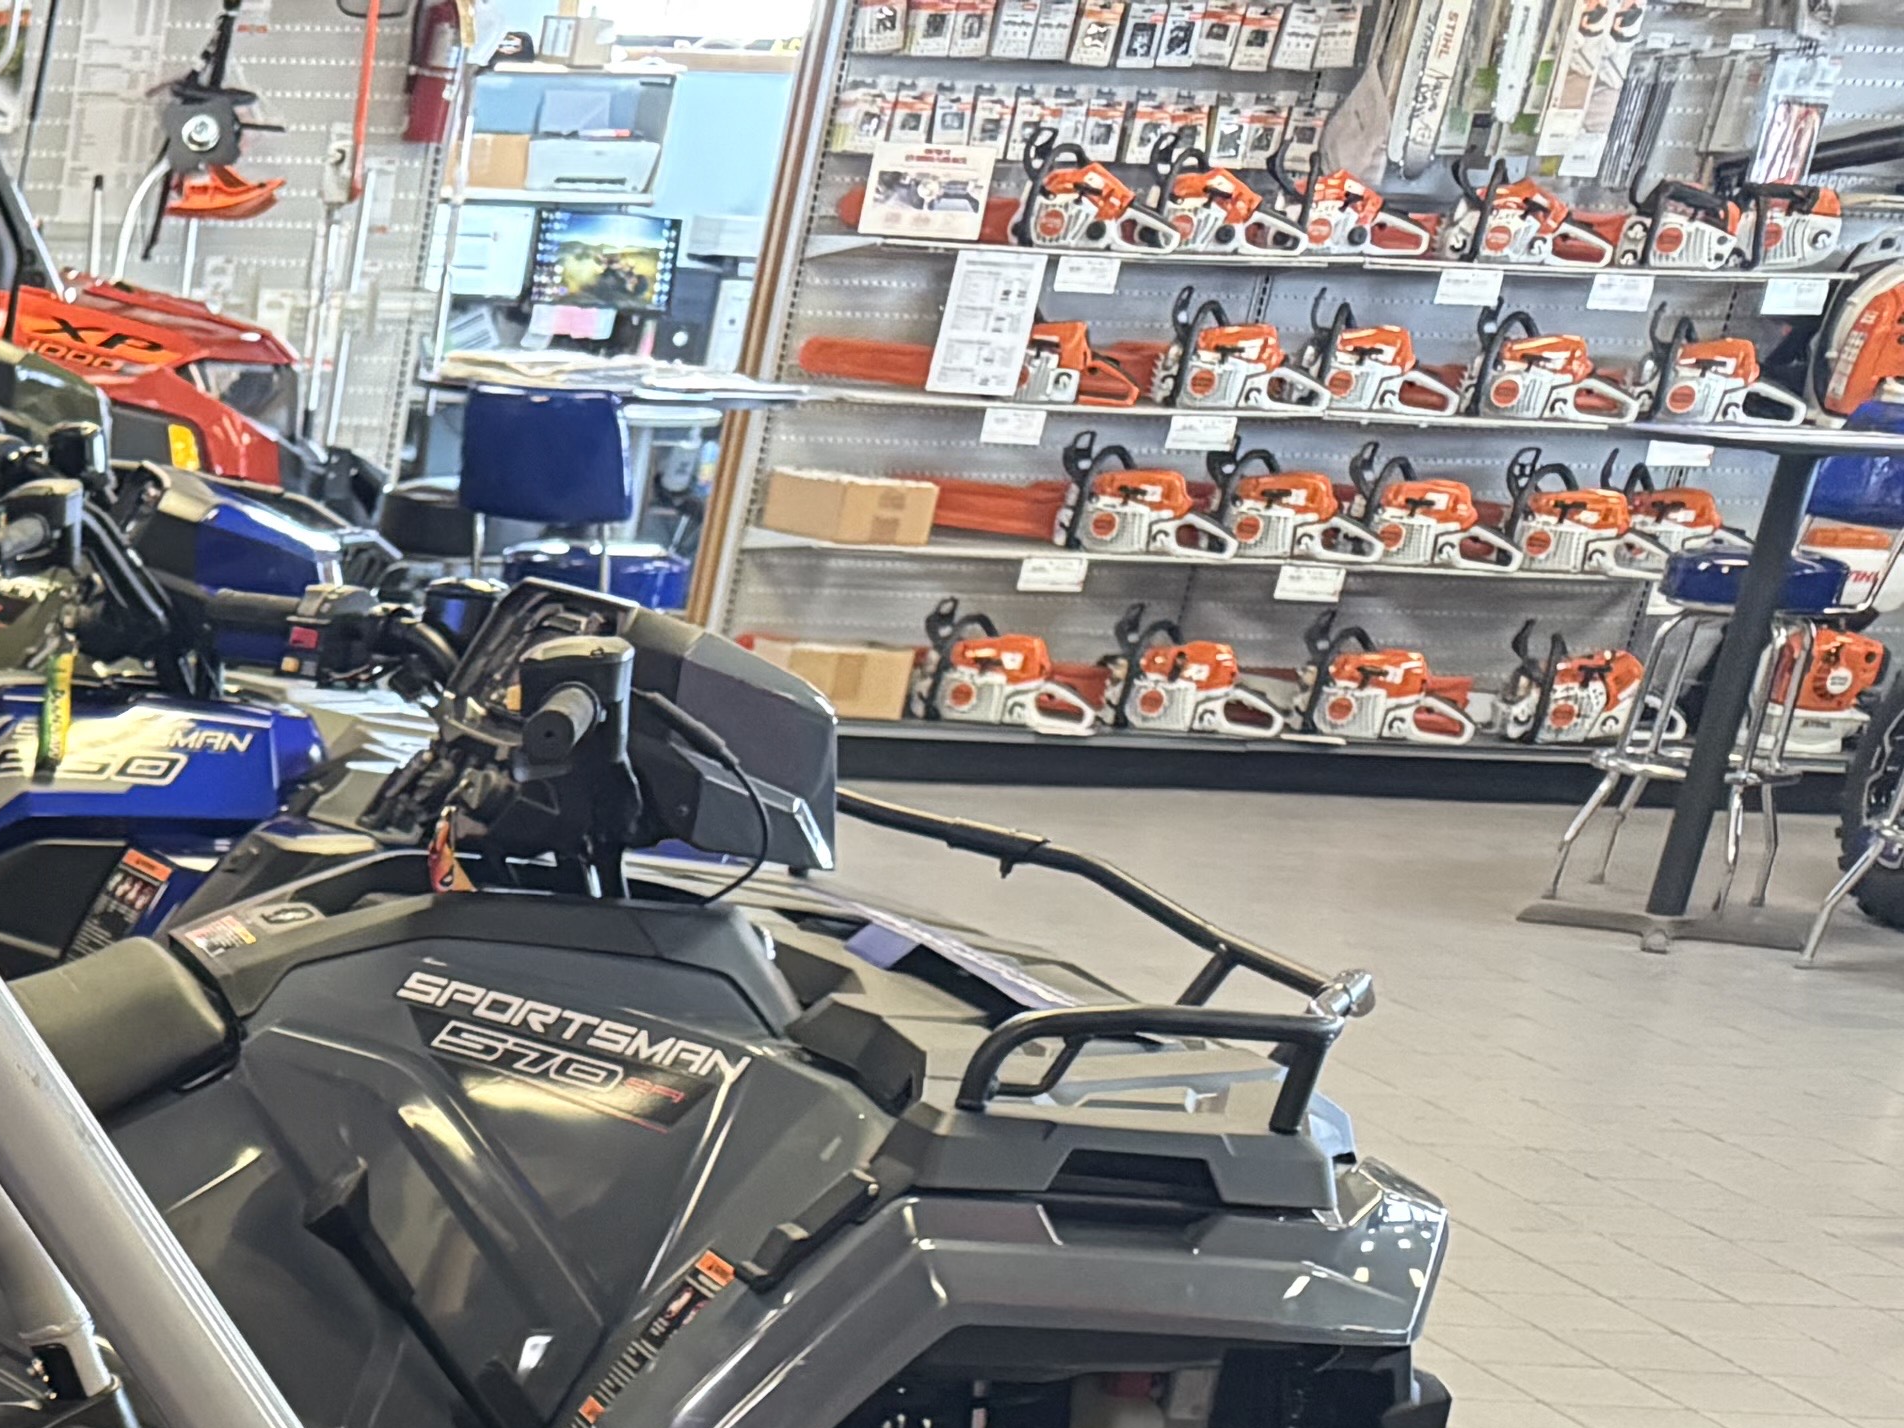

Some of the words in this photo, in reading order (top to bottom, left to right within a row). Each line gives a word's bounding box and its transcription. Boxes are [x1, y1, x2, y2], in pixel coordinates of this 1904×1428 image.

[1438, 11, 1459, 58] STIHL
[28, 339, 124, 372] 1000
[33, 315, 163, 351] XP
[396, 970, 752, 1078] SPORTSMAN
[431, 1020, 626, 1094] 570
